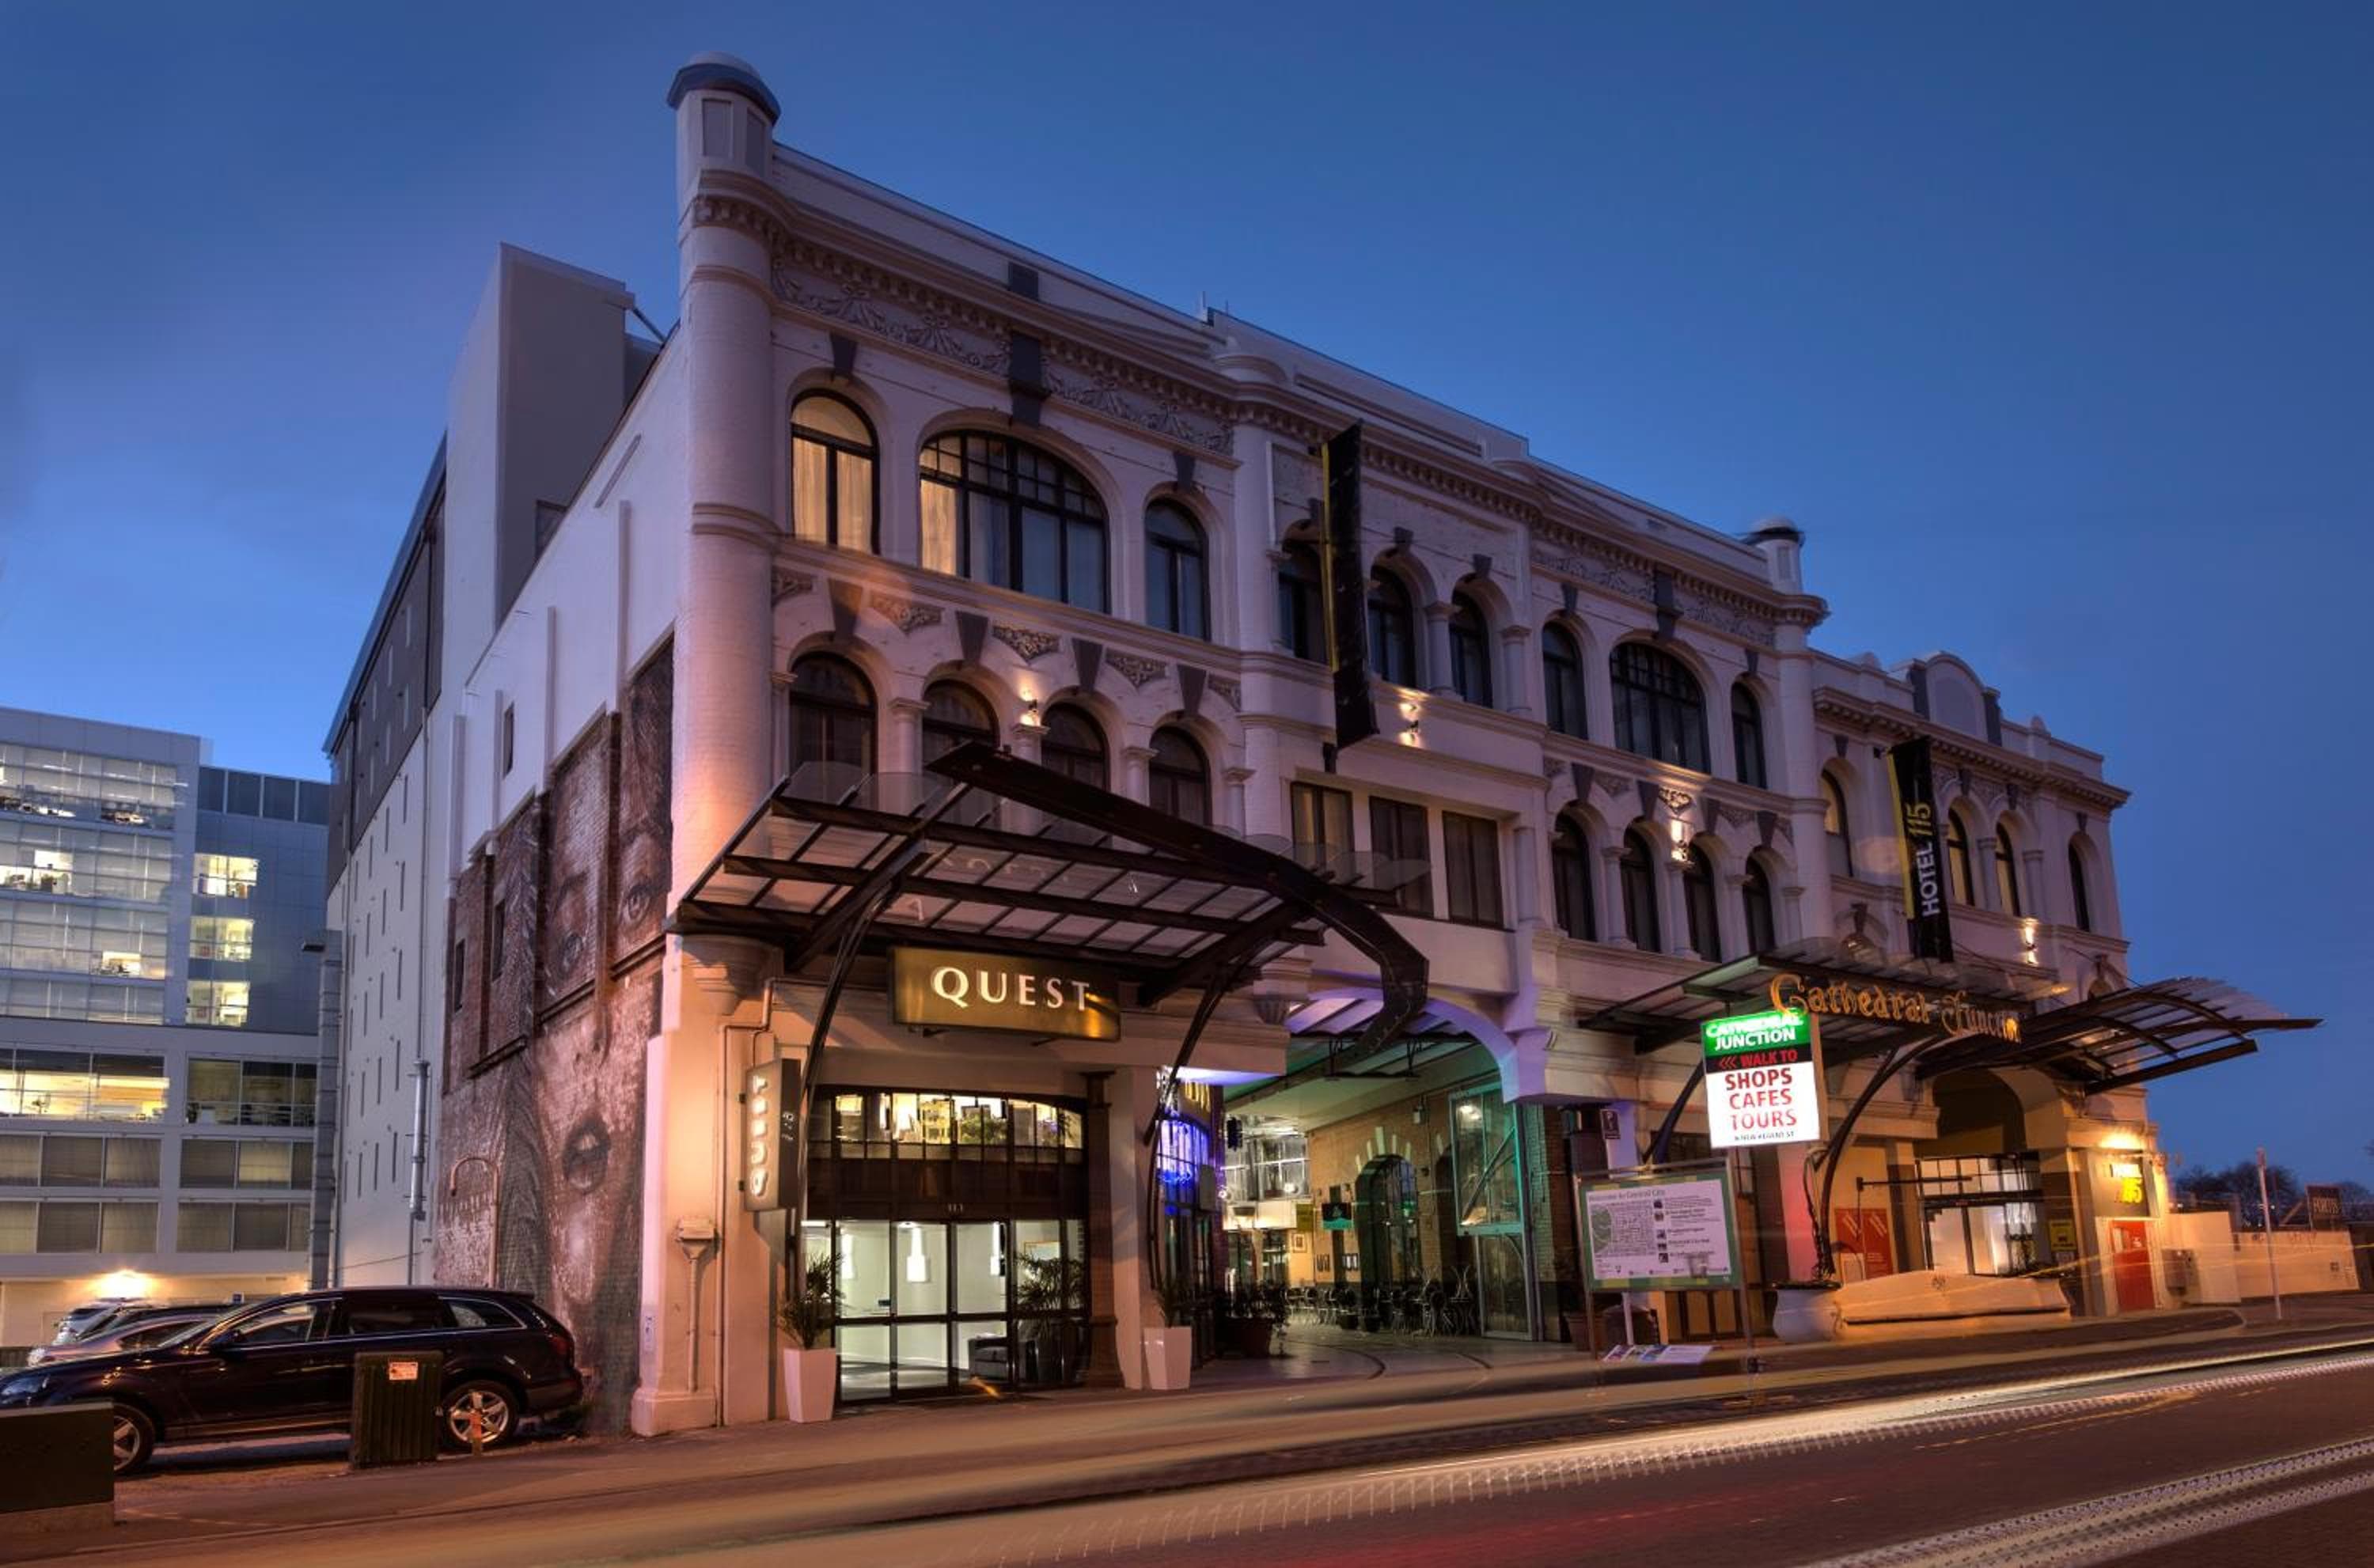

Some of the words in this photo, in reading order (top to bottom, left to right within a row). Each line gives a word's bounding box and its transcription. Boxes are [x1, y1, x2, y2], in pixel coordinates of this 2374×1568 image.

[1915, 842, 1941, 918] HOTEL
[931, 966, 1090, 1011] QUEST
[1706, 1013, 1804, 1038] CATHAL
[1715, 1026, 1796, 1051] JUNCTION
[1740, 1051, 1777, 1068] WALK
[1780, 1050, 1799, 1062] TO
[1724, 1067, 1793, 1091] SHOPS
[1729, 1088, 1793, 1110] CAFES
[1731, 1108, 1797, 1131] TOURS
